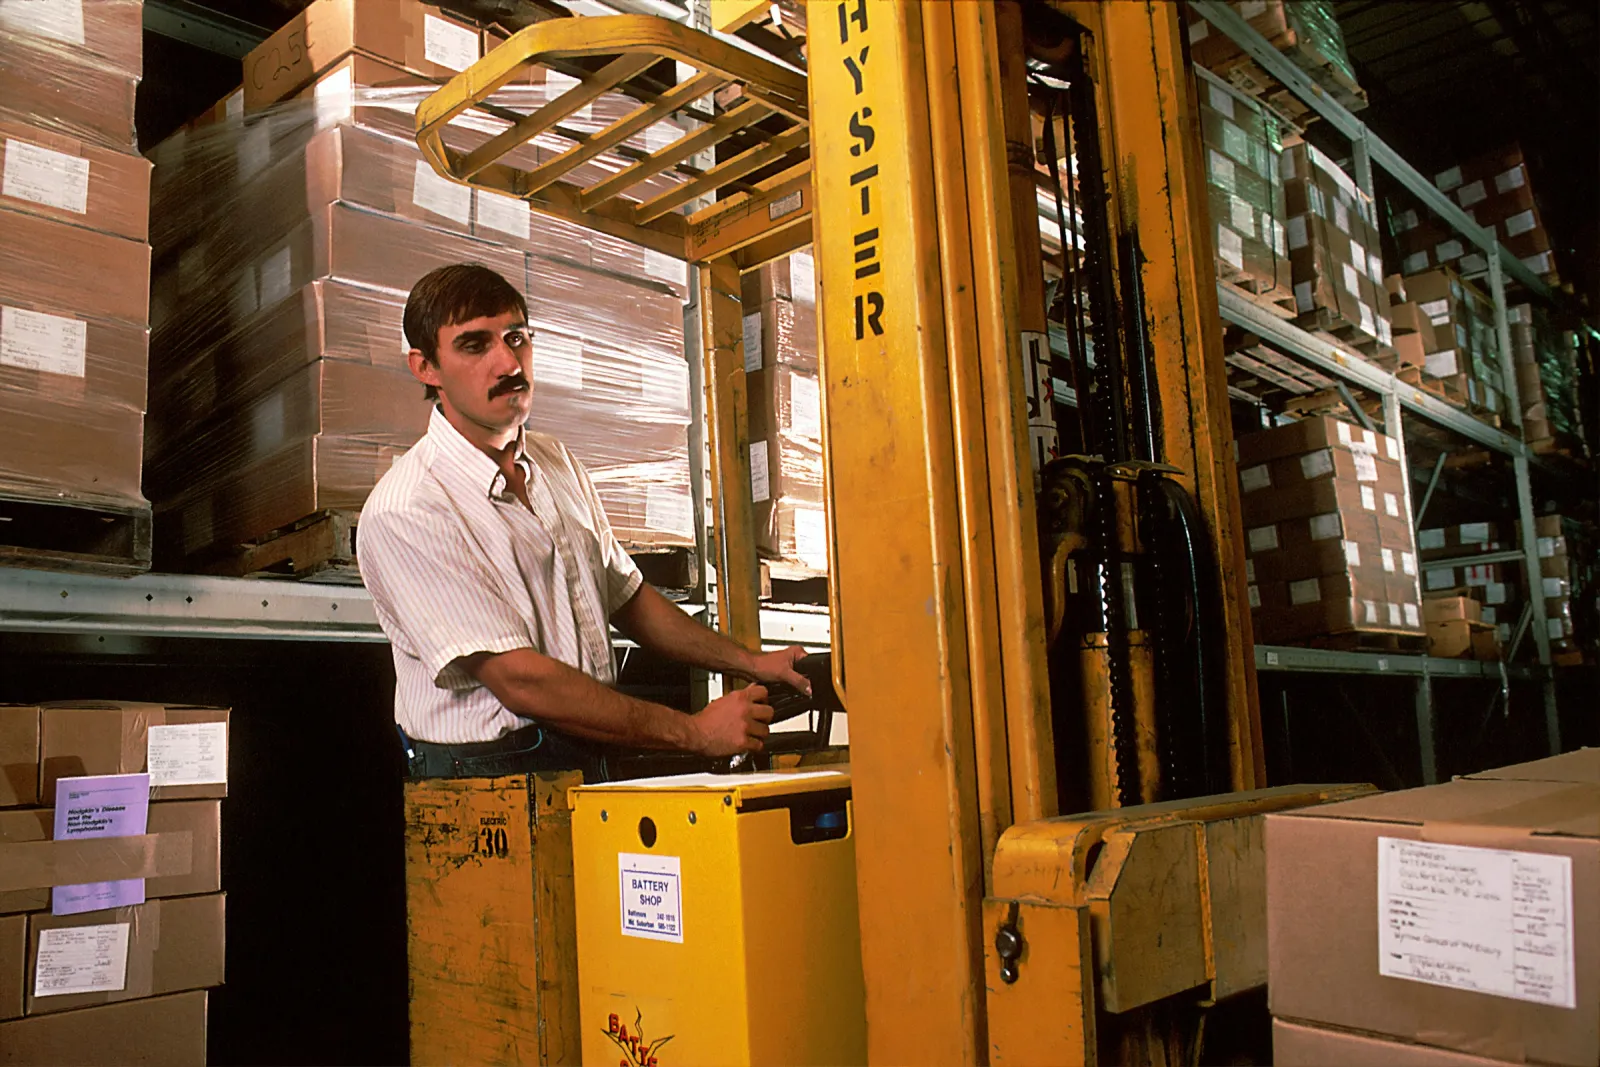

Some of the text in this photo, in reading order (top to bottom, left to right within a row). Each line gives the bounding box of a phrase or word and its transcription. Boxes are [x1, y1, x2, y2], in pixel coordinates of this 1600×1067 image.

[838, 0, 884, 341] HYSTER
[632, 879, 669, 893] BATTERY
[639, 894, 662, 907] SHOP
